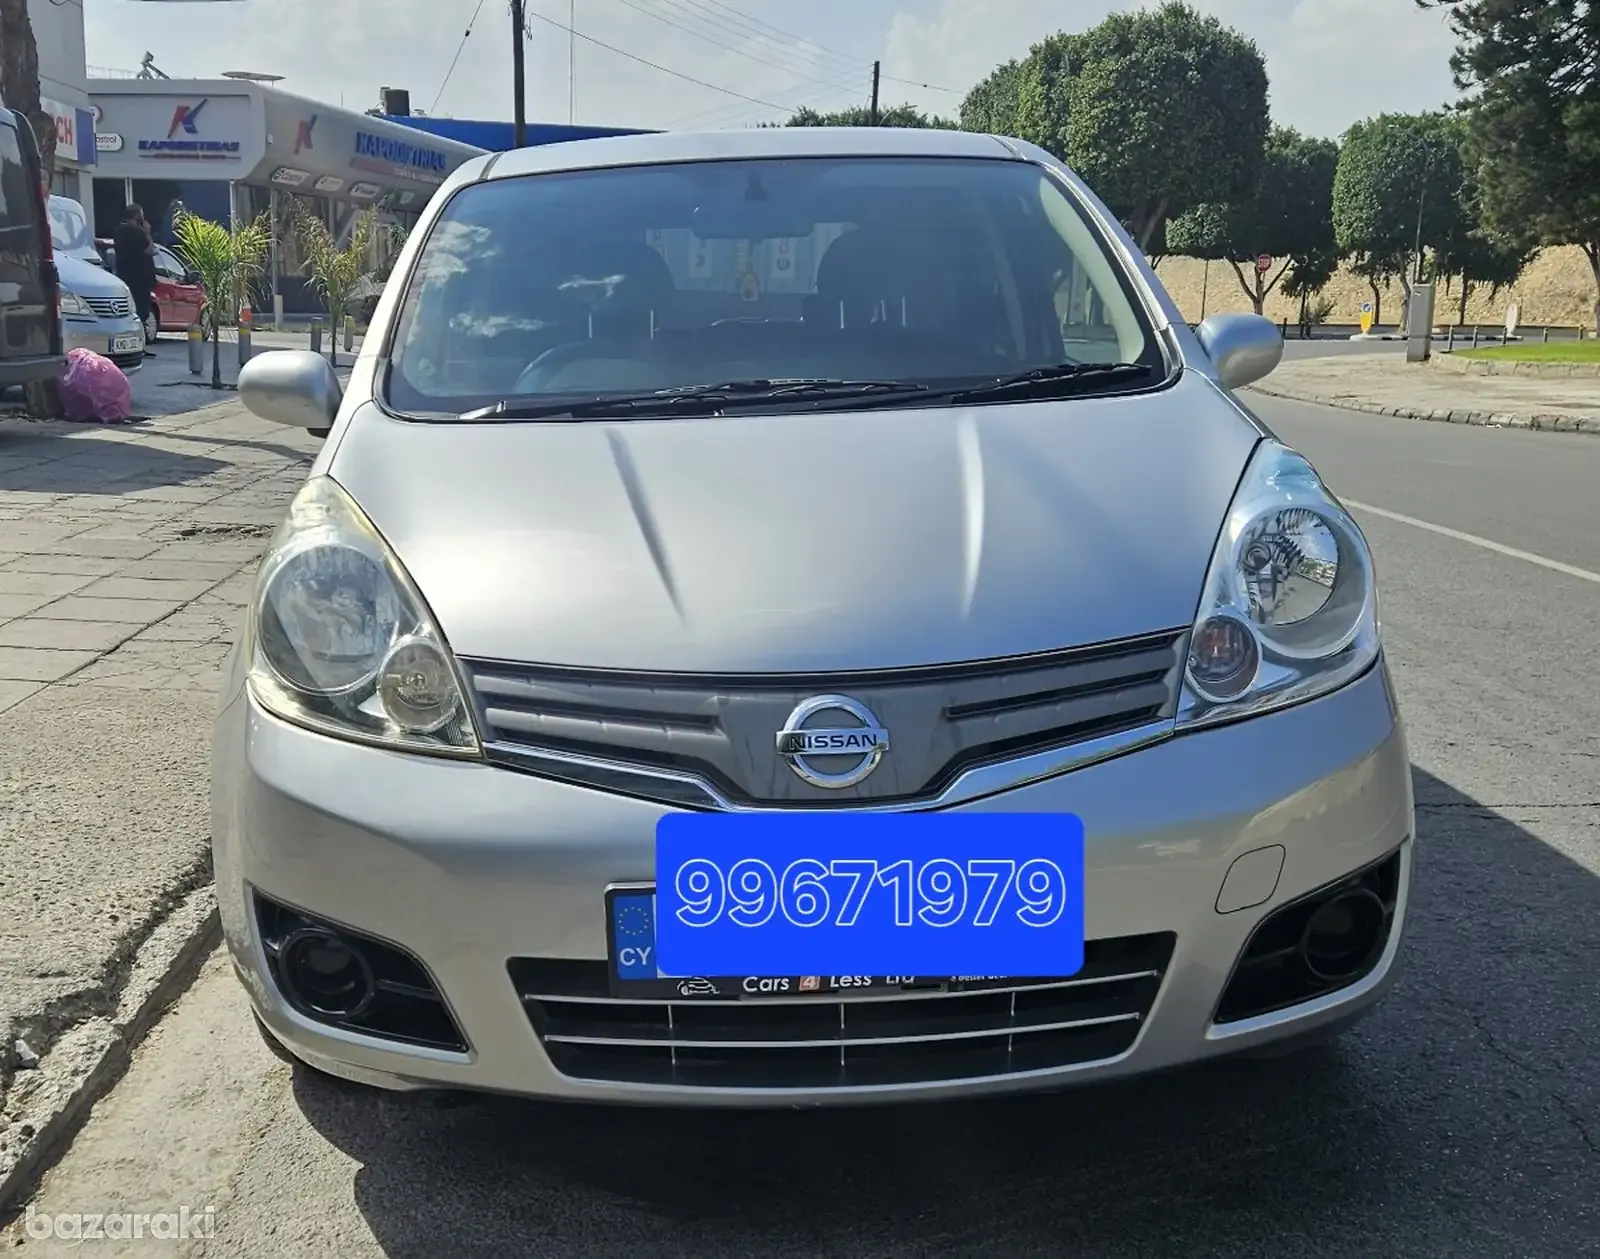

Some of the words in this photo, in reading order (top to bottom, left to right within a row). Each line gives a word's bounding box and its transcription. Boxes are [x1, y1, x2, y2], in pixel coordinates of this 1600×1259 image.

[96, 135, 117, 144] astrol
[790, 734, 877, 749] NISSAN
[619, 947, 652, 966] CY
[742, 976, 790, 992] Cars
[830, 976, 872, 987] Less
